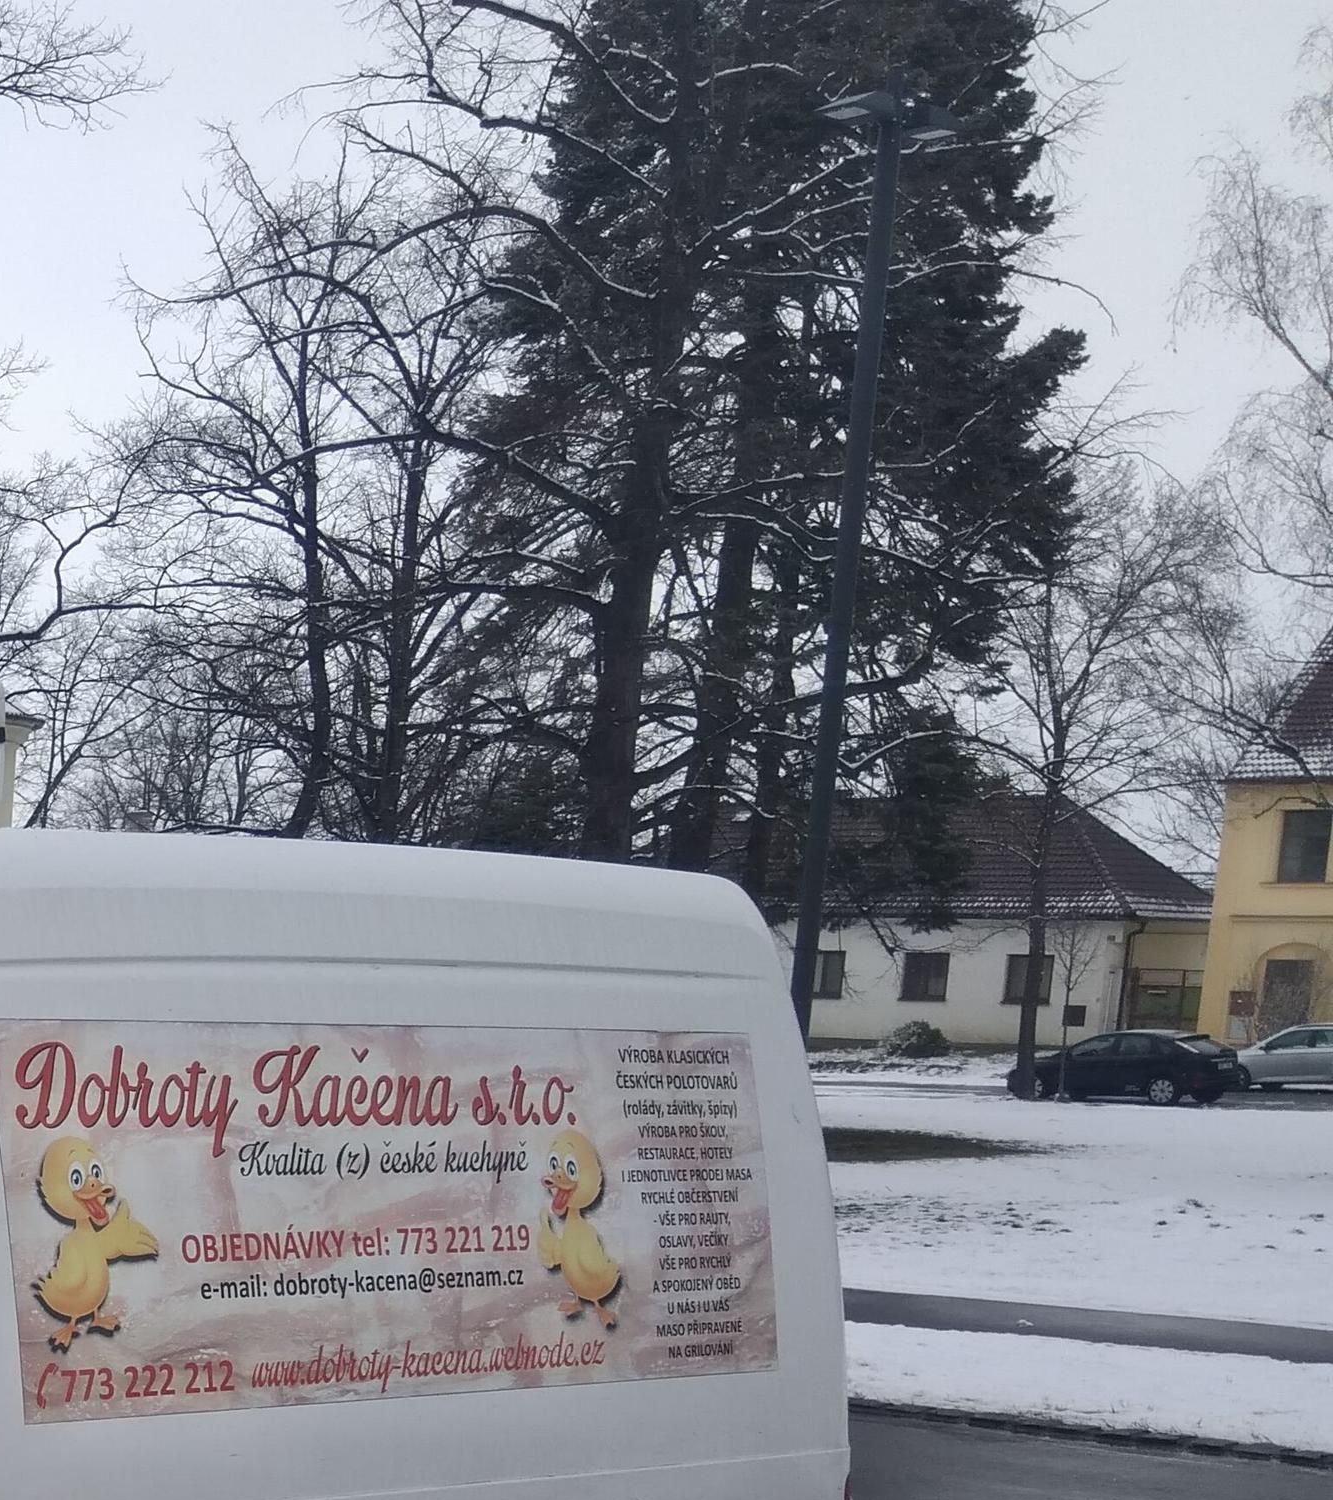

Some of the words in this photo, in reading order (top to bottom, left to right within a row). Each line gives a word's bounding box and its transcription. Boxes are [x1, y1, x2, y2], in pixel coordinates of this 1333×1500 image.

[618, 1046, 664, 1064] VÝROBA
[667, 1047, 730, 1065] KLASICKÝCH
[616, 1071, 664, 1090] ČESKÝCH
[666, 1072, 738, 1090] POLOTOVARŮ
[15, 1041, 238, 1158] Dobroty
[253, 1044, 458, 1127] Kačena
[471, 1065, 577, 1126] s.r.o.
[623, 1099, 665, 1118] (rolády,
[667, 1100, 707, 1118] závitky,
[638, 1123, 678, 1139] VÝROBA
[679, 1125, 698, 1138] PRO
[238, 1141, 327, 1177] Kvalita
[336, 1142, 370, 1180] (z)
[380, 1141, 438, 1174] české
[444, 1140, 529, 1184] kuchyně
[637, 1147, 699, 1161] RESTAURACE,
[701, 1147, 733, 1160] HOTELY
[627, 1169, 688, 1182] JEDNOTLIVCE
[690, 1169, 724, 1181] PRODEJ
[726, 1168, 753, 1180] MASA
[641, 1188, 675, 1204] RYCHLÉ
[678, 1187, 739, 1203] OBČERSTVENÍ
[659, 1211, 676, 1226] VŠE
[679, 1213, 697, 1226] PRO
[700, 1212, 731, 1226] RAUTY,
[181, 1224, 345, 1264] OBJEDNÁVKY
[352, 1228, 390, 1258] tel:
[396, 1227, 438, 1257] 773
[445, 1225, 484, 1253] 221
[491, 1223, 530, 1252] 219
[659, 1235, 696, 1249] OSLAVY,
[659, 1255, 676, 1270] VŠE
[679, 1257, 697, 1270] PRO
[700, 1253, 732, 1269] RYCHLÝ
[200, 1273, 268, 1300] e-mail:
[273, 1267, 524, 1299] dobroty-kacena@seznam.cz
[653, 1280, 660, 1293] A
[662, 1276, 713, 1293] SPOKOJENÝ
[716, 1275, 741, 1290] OBĚD
[667, 1302, 674, 1314] U
[677, 1299, 696, 1313] NÁS
[704, 1300, 712, 1312] U
[714, 1298, 730, 1312] VÁS
[656, 1324, 685, 1337] MASO
[687, 1318, 742, 1335] PŘIPRAVENÉ
[669, 1346, 682, 1359] NA
[685, 1340, 733, 1357] GRILOVÁNÍ
[251, 1331, 606, 1393] www.dobroty-kacena.webnode.cz
[60, 1368, 114, 1402] 773
[124, 1363, 176, 1398] 222
[184, 1359, 235, 1394] 212
